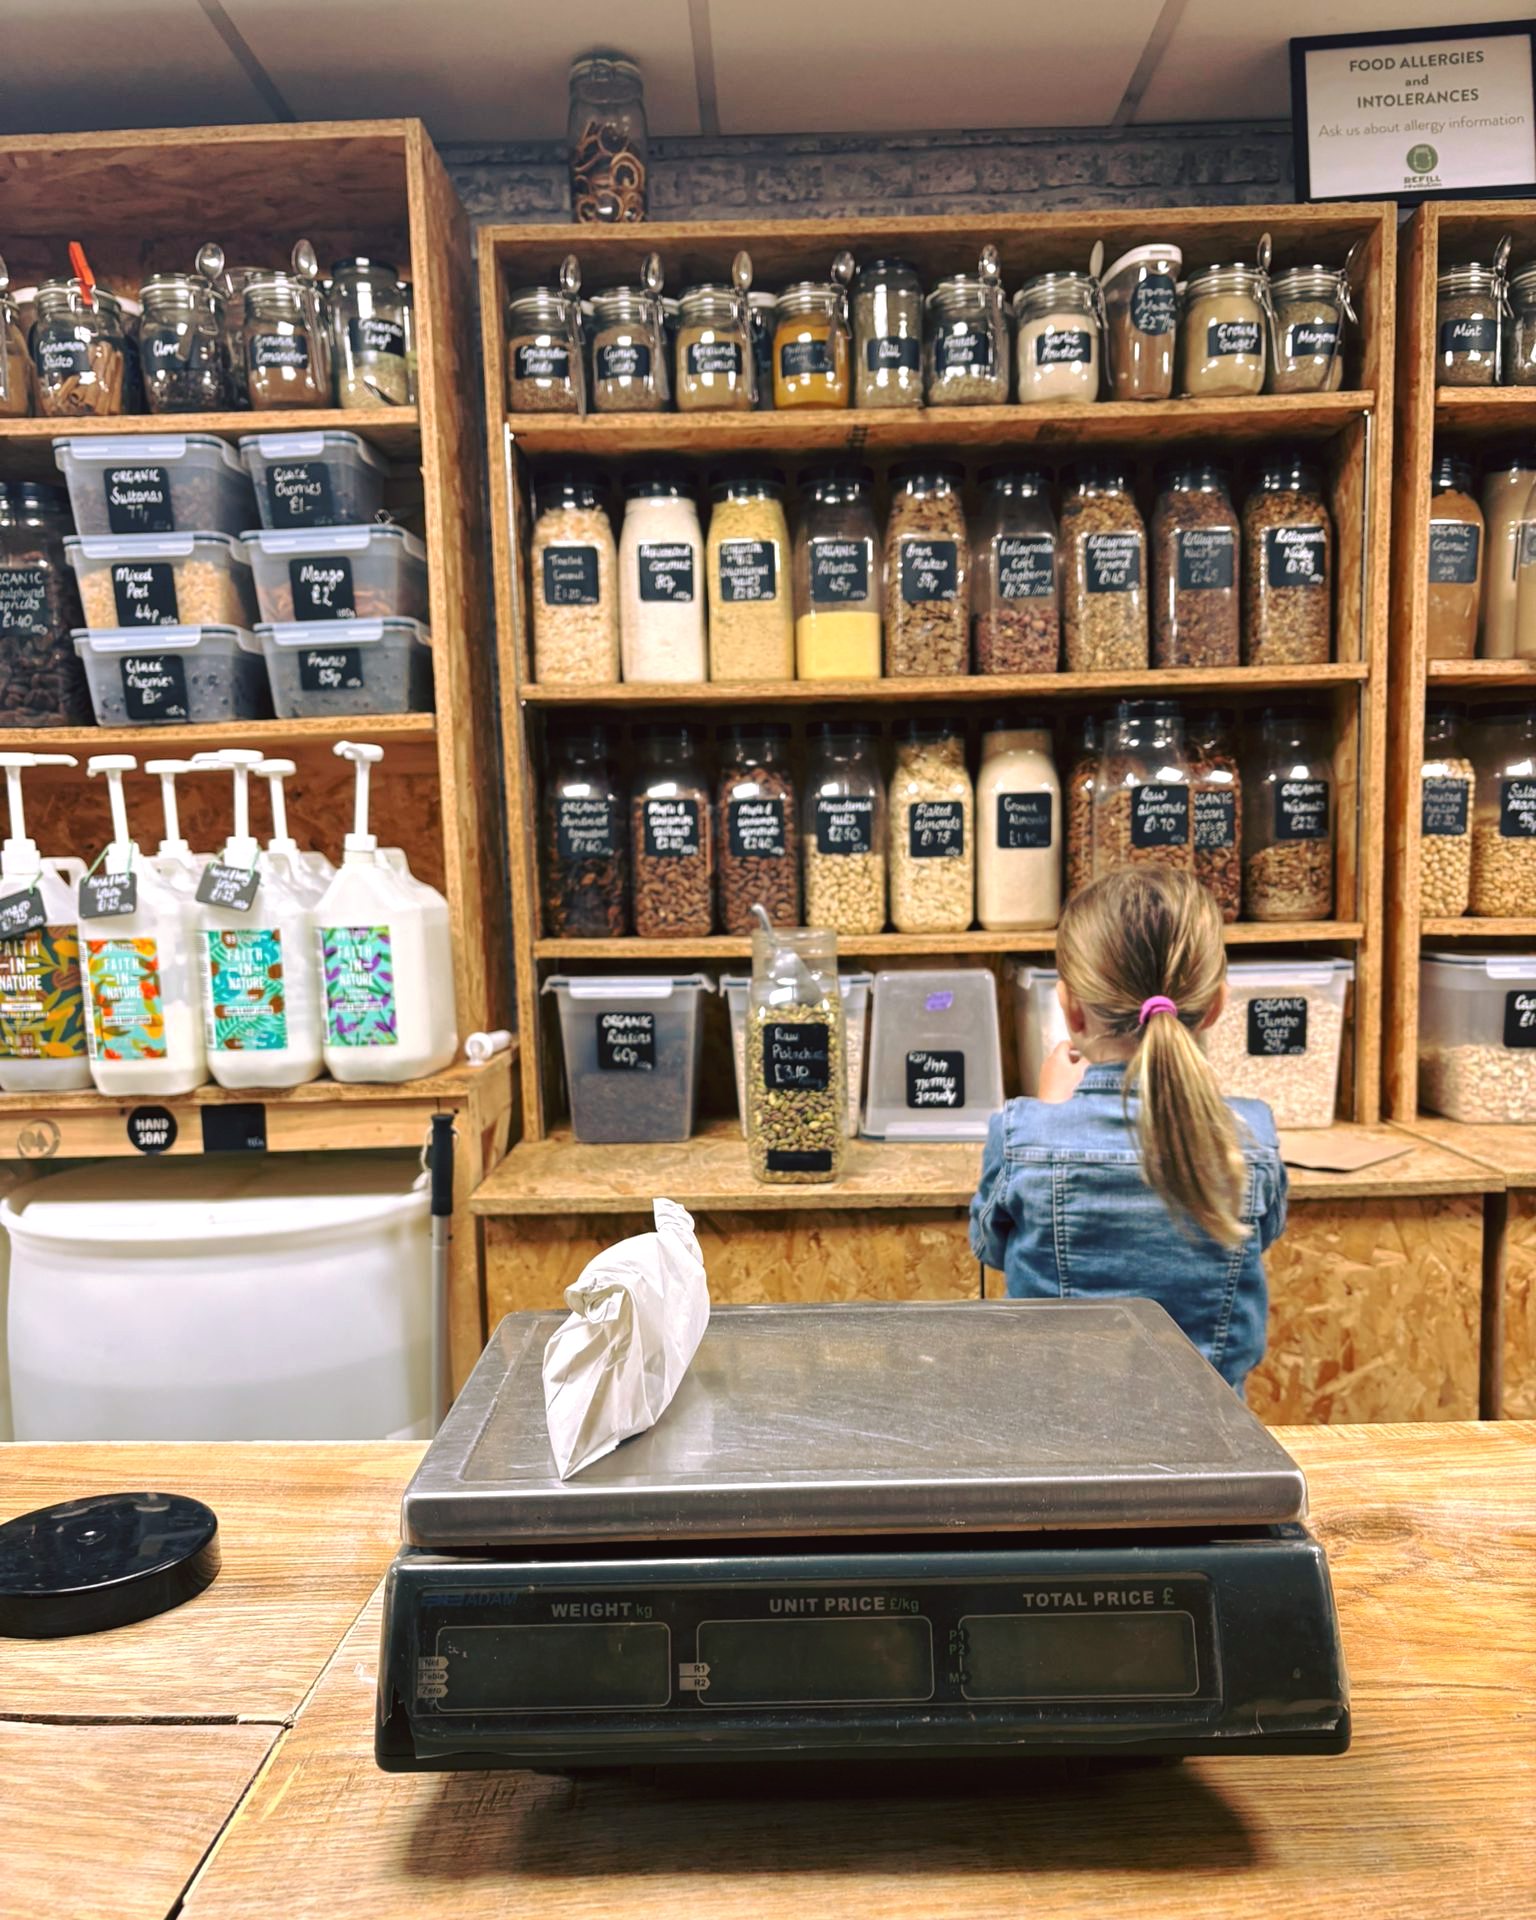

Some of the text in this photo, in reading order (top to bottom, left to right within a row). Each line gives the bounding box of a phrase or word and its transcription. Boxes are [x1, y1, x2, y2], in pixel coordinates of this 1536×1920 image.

[1349, 51, 1484, 72] FOOD ALLERGIES
[1405, 75, 1429, 87] and
[1357, 88, 1479, 108] INTOLERANCES
[1318, 114, 1525, 138] Ask us about allergy information
[1453, 323, 1483, 338] Mint
[1043, 332, 1080, 346] Garlic
[692, 343, 737, 358] Ground
[1042, 346, 1083, 360] Powder
[696, 358, 737, 372] Cumin
[111, 469, 160, 484] ORGANIC
[109, 486, 163, 505] Sultanas
[816, 544, 859, 558] ORGANIC
[300, 566, 345, 590] Mango
[1140, 786, 1168, 802] Raw
[1004, 797, 1039, 813] Ground
[914, 816, 960, 831] almonds
[0, 940, 39, 957] AITH
[226, 949, 263, 961] FAITH
[337, 945, 372, 958] FAITH
[9, 958, 26, 973] IN
[104, 958, 139, 971] FAITH
[240, 963, 252, 975] IN
[350, 960, 362, 971] IN
[0, 975, 42, 990] NATURE
[116, 973, 129, 985] IN
[229, 977, 265, 990] NATURE
[339, 974, 373, 986] NATURE
[106, 987, 142, 1000] NATURE
[1254, 999, 1305, 1013] ORGANIC
[602, 1015, 653, 1029] ORGANIC
[1257, 1012, 1300, 1028] Jumbo
[606, 1028, 651, 1045] Raisins
[774, 1027, 799, 1041] Raw
[914, 1088, 958, 1106] Apricot
[135, 1118, 169, 1131] HAND
[138, 1132, 168, 1145] SOAP
[464, 1592, 518, 1606] ADAM
[1023, 1587, 1175, 1607] TOTAL PRICE £
[551, 1602, 653, 1619] WEIGHT kg
[769, 1596, 920, 1613] UNIT PRICE £/kg
[949, 1629, 966, 1641] P1
[949, 1644, 966, 1655] P2
[694, 1664, 706, 1674] R1
[694, 1678, 707, 1688] R2
[949, 1672, 968, 1684] M+
[422, 1687, 442, 1695] Zero
